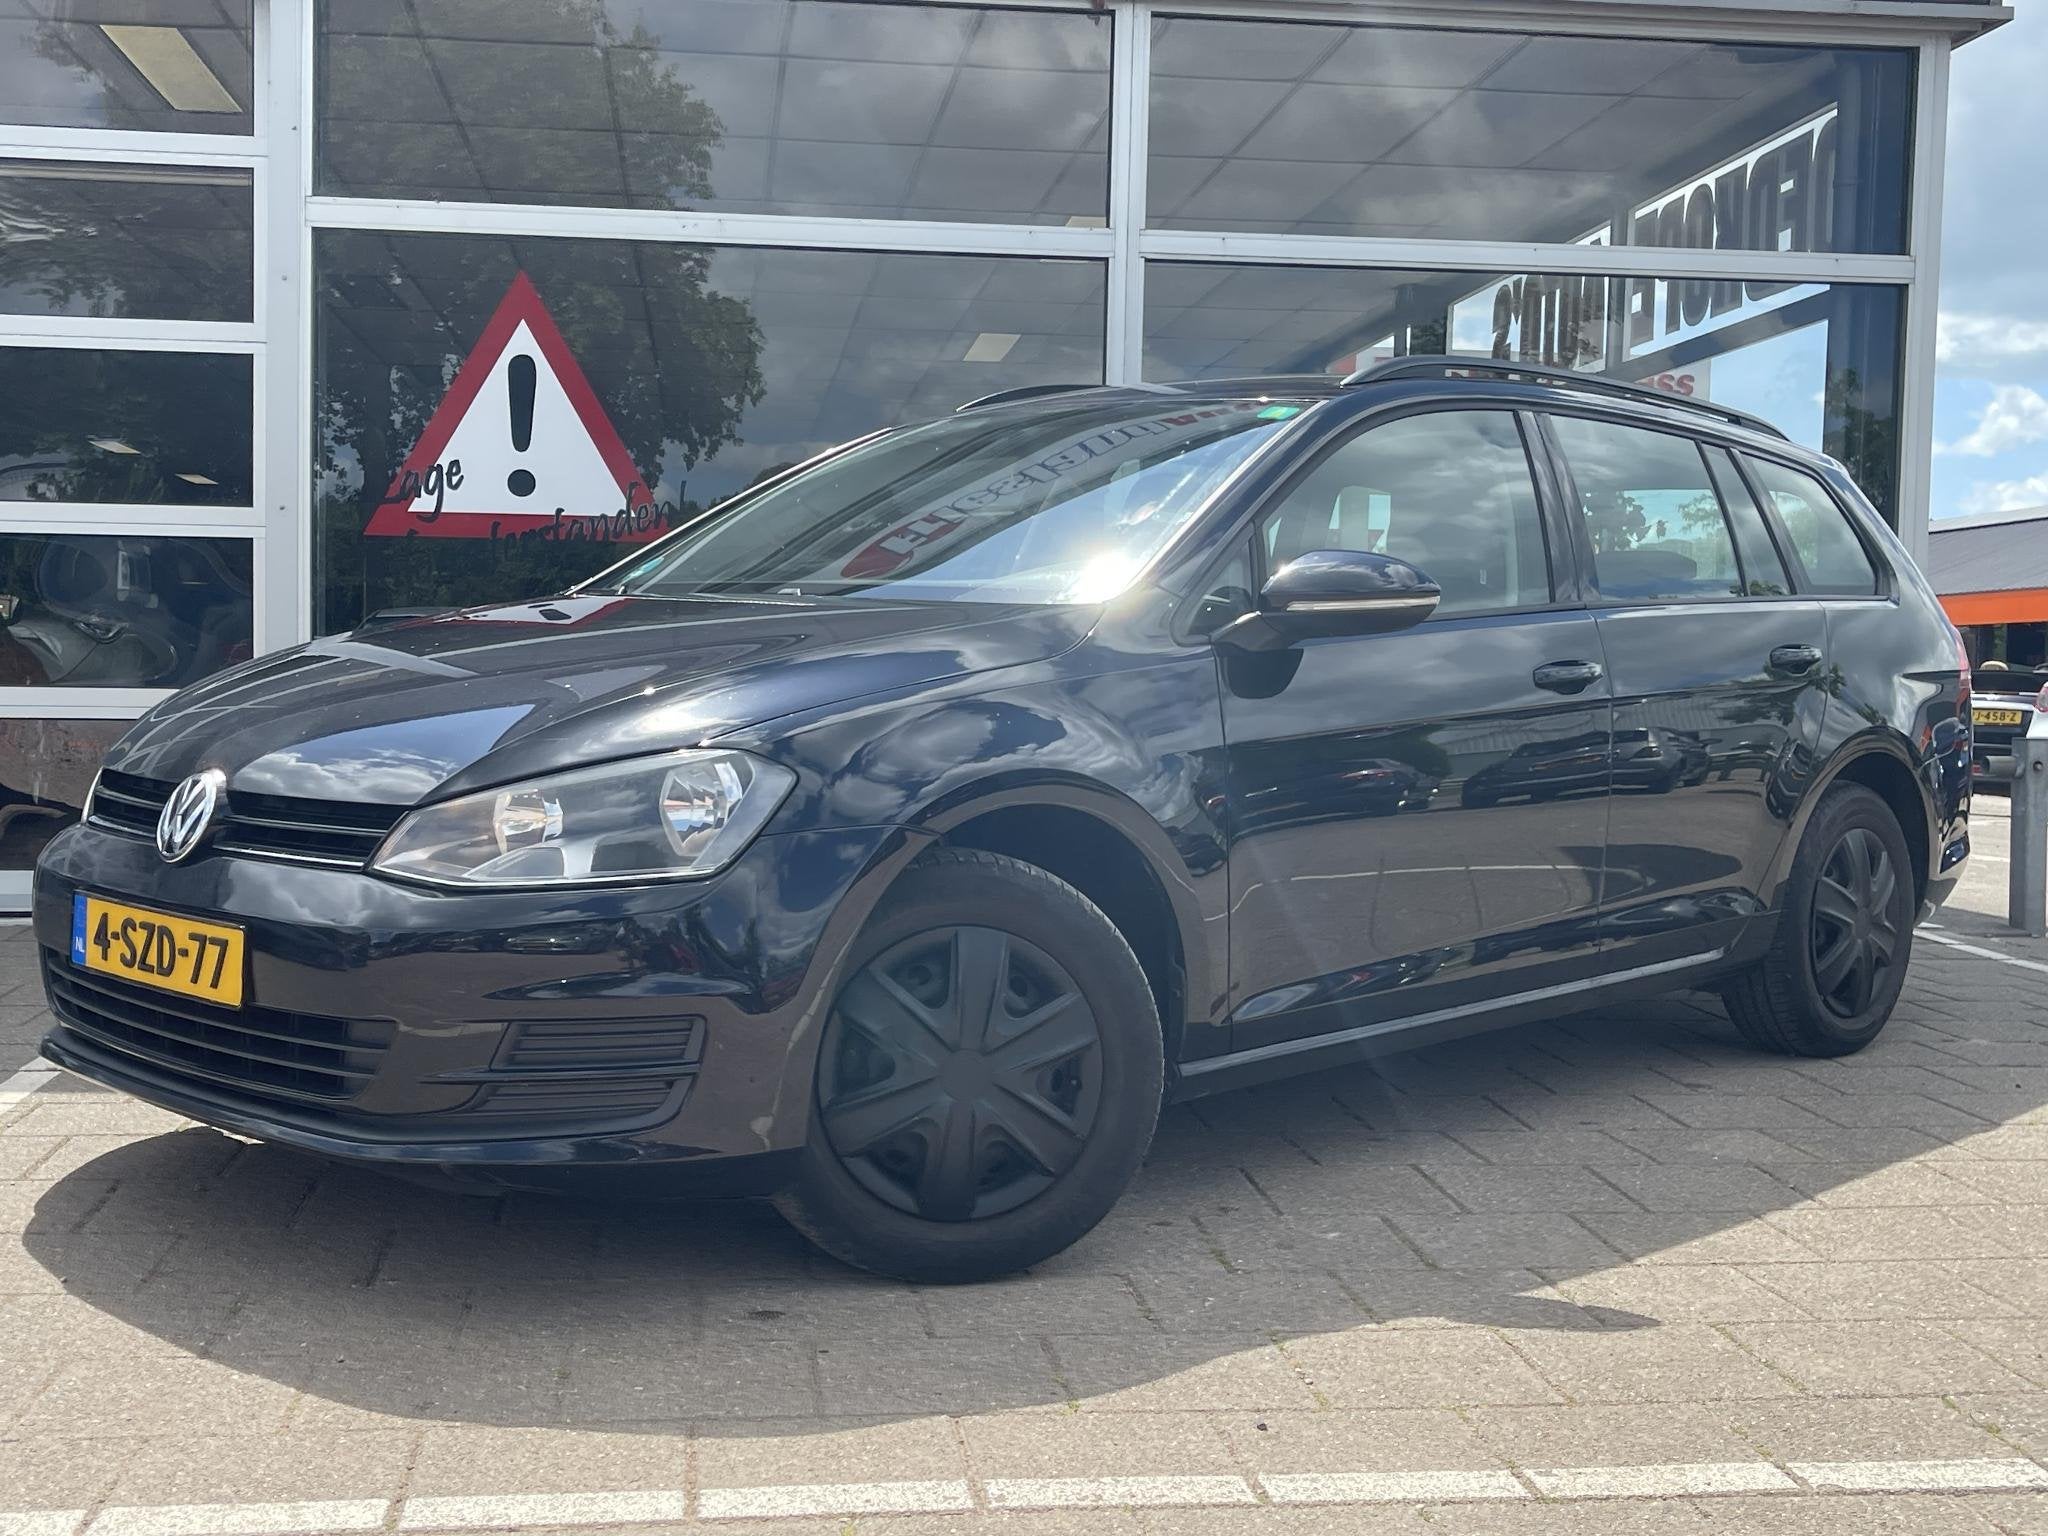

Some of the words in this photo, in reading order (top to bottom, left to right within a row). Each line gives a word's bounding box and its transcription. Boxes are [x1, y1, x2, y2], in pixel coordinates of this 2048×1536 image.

[1972, 711, 2017, 721] J-458-Z
[75, 936, 85, 953] NL
[93, 912, 229, 989] 4-SZD-77
